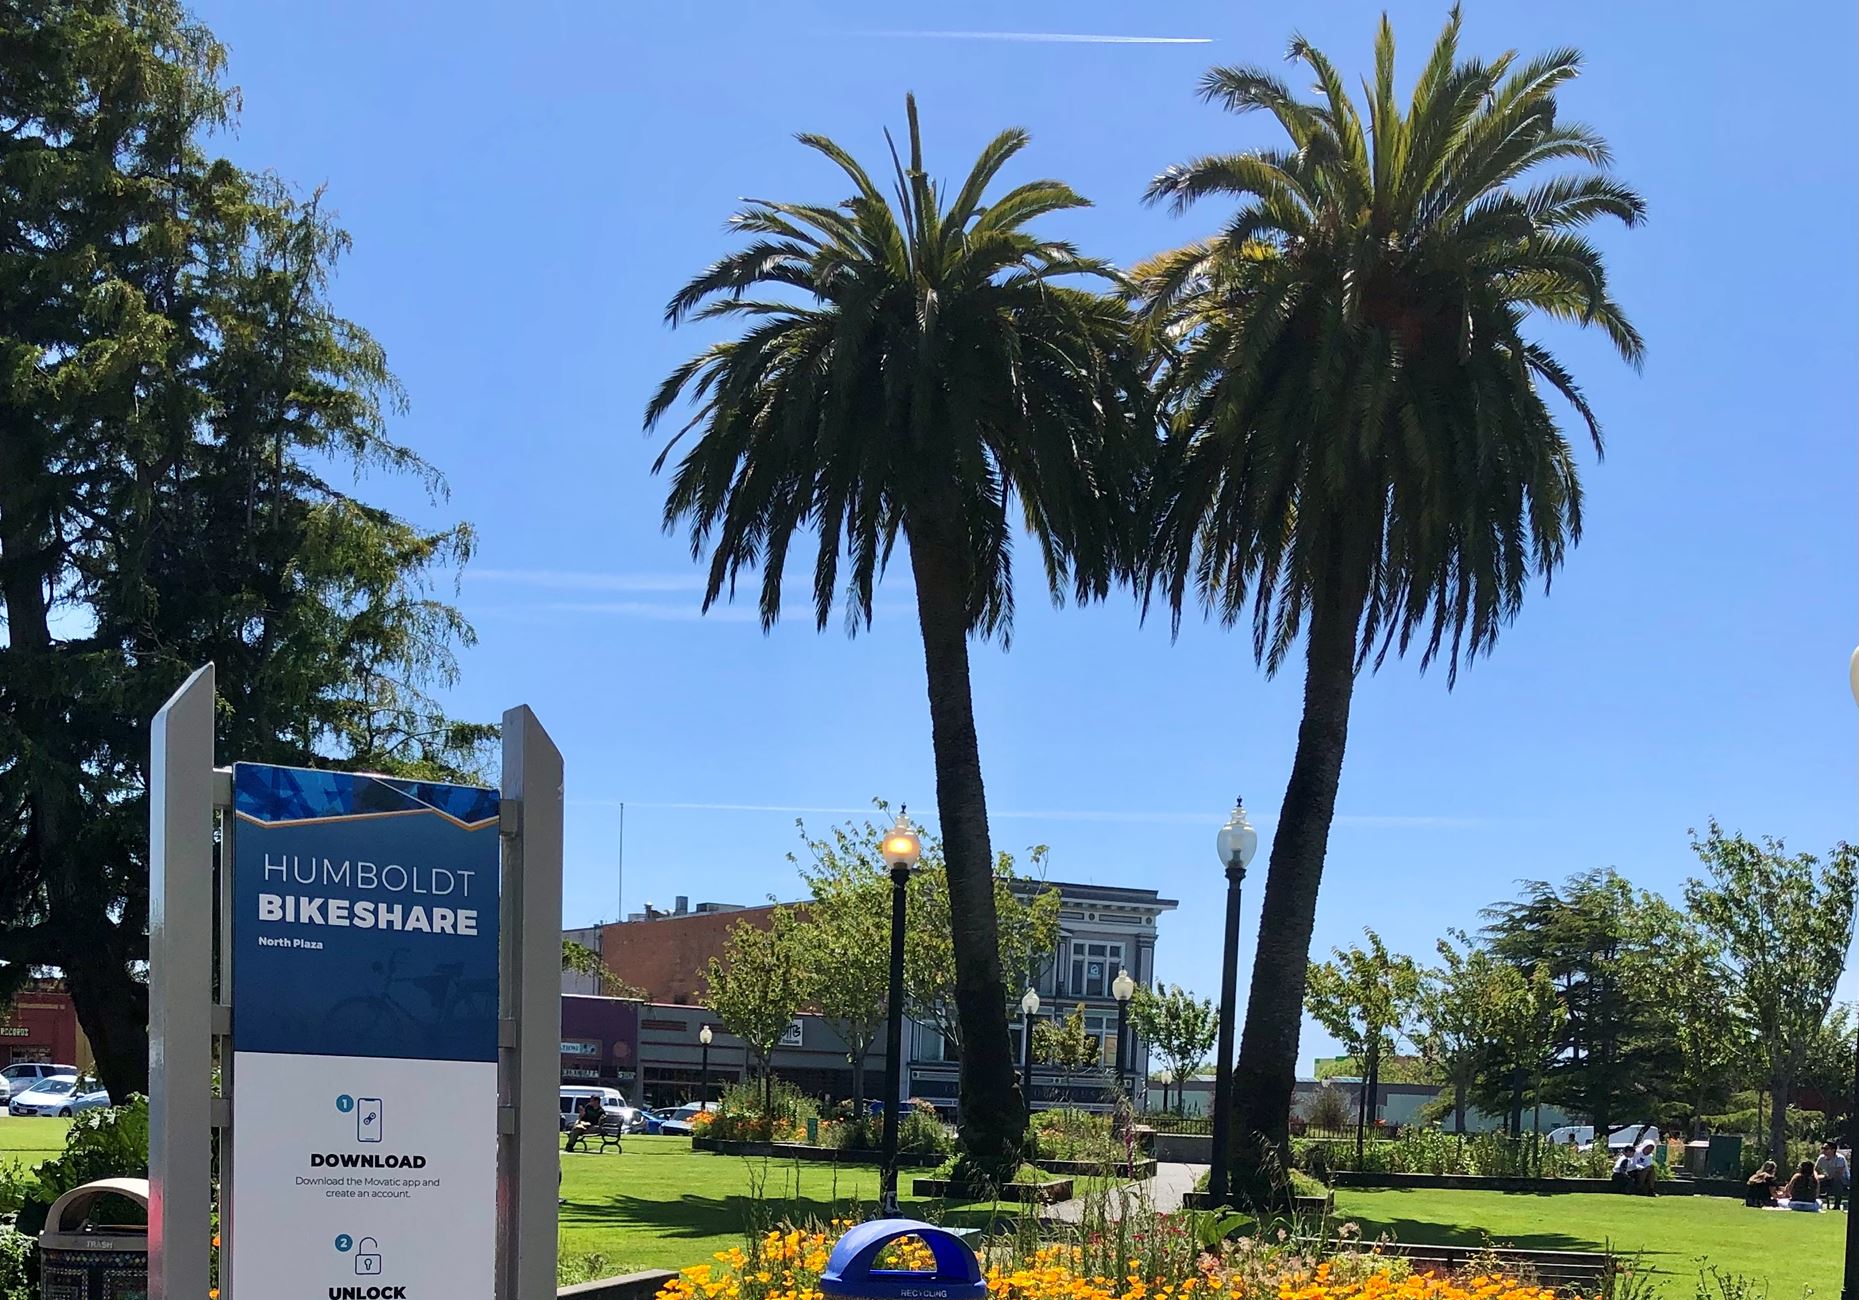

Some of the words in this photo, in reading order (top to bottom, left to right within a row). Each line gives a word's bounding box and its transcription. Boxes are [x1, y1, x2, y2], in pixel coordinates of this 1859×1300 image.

[264, 853, 475, 897] HUMBOLDT
[258, 893, 478, 936] BIKESHARE
[258, 936, 291, 947] North
[293, 939, 323, 949] Plaza
[310, 1153, 427, 1169] DOWNLOAD
[295, 1176, 344, 1186] Download
[347, 1177, 363, 1186] the
[364, 1178, 400, 1186] Movatic
[402, 1180, 420, 1188] app
[422, 1178, 440, 1187] and
[371, 1190, 411, 1198] account.
[86, 1241, 113, 1249] TRASH
[329, 1286, 406, 1300] UNLOCK
[901, 1289, 947, 1298] RECYCLING
